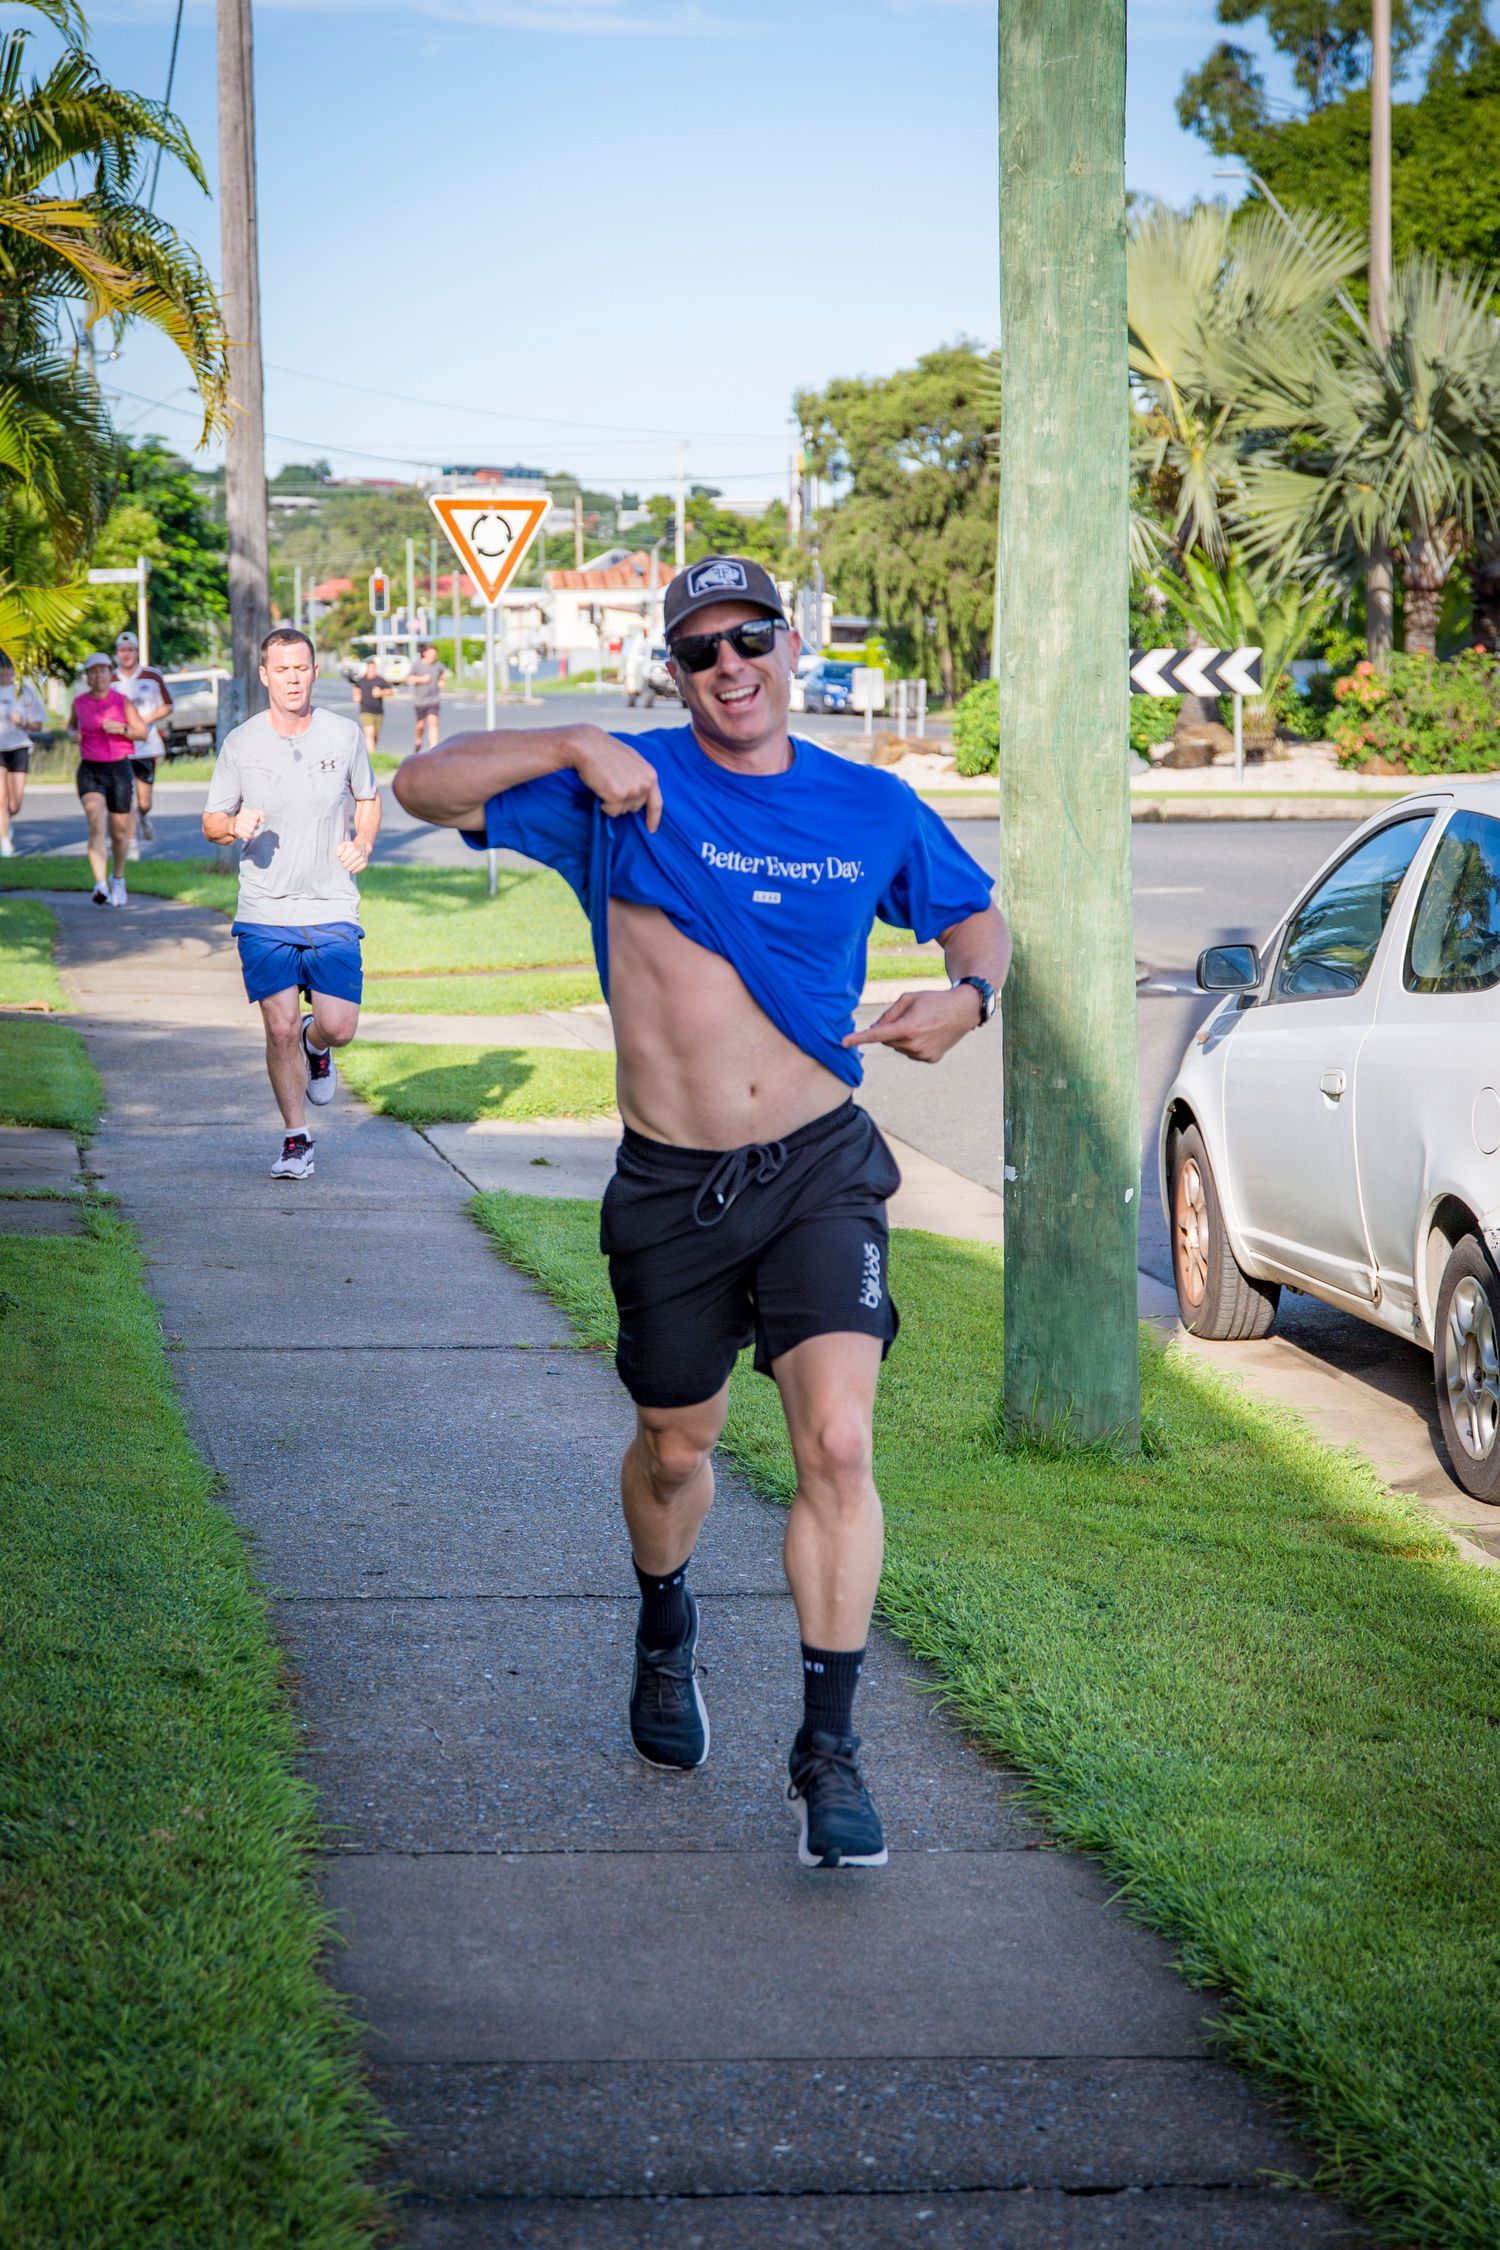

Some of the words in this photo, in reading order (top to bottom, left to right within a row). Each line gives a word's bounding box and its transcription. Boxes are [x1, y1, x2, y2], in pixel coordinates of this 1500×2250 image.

[701, 841, 764, 874] Better
[765, 856, 824, 884] Every
[826, 856, 865, 883] Day.
